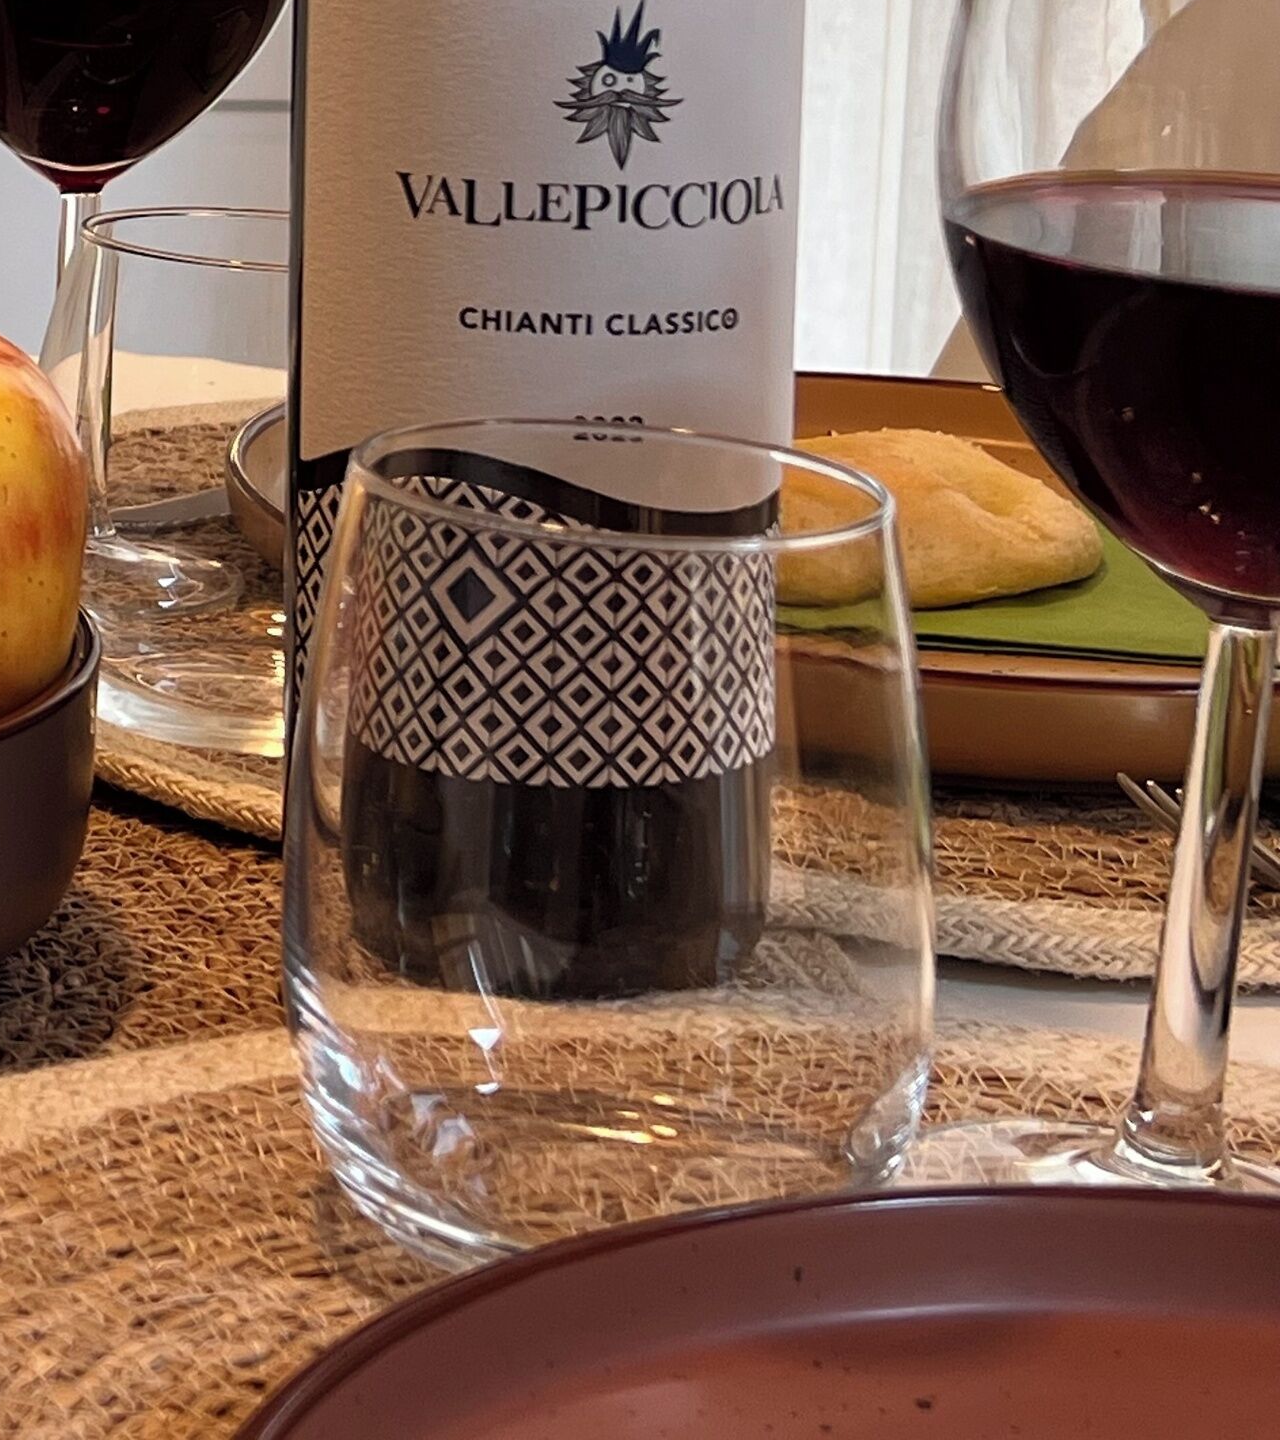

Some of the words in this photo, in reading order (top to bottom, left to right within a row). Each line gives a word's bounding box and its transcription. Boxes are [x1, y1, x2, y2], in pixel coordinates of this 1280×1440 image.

[396, 171, 784, 230] VALLEPICCIOLA
[459, 306, 593, 335] CHIANTI
[605, 307, 739, 336] CLASSICO
